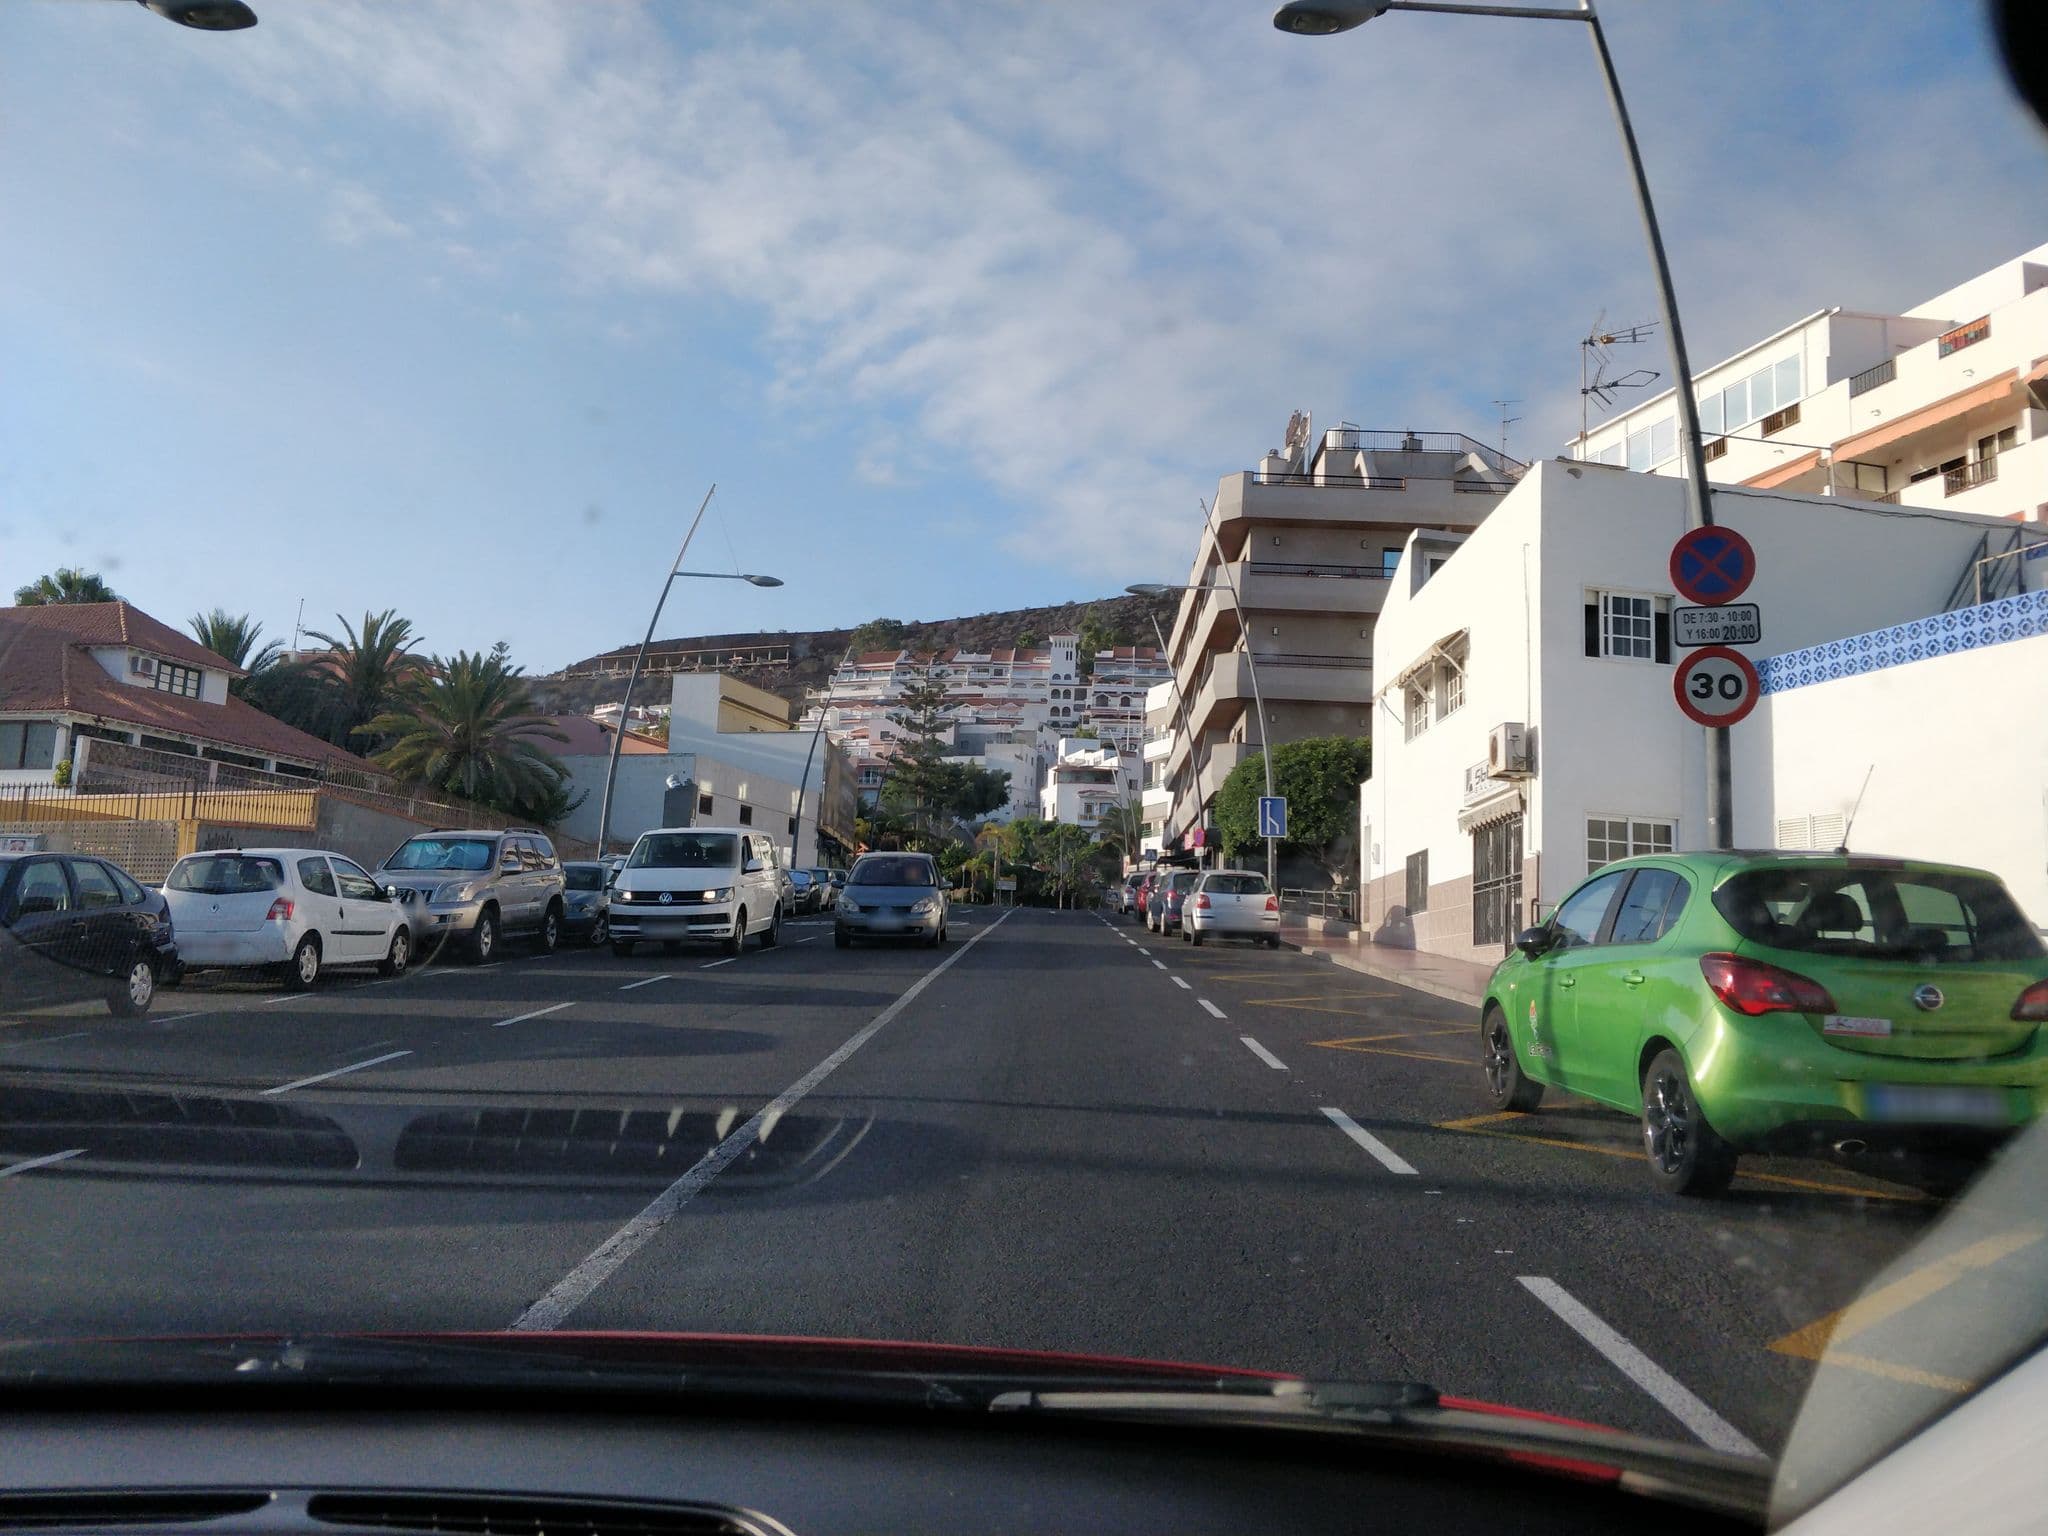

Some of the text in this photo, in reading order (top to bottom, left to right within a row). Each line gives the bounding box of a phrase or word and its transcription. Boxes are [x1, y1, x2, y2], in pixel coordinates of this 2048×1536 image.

[1683, 613, 1696, 624] DE
[1699, 612, 1718, 623] 7:30
[1727, 611, 1751, 622] 10:00
[1686, 625, 1755, 640] Y 16:00 20:00
[1692, 673, 1742, 700] 30
